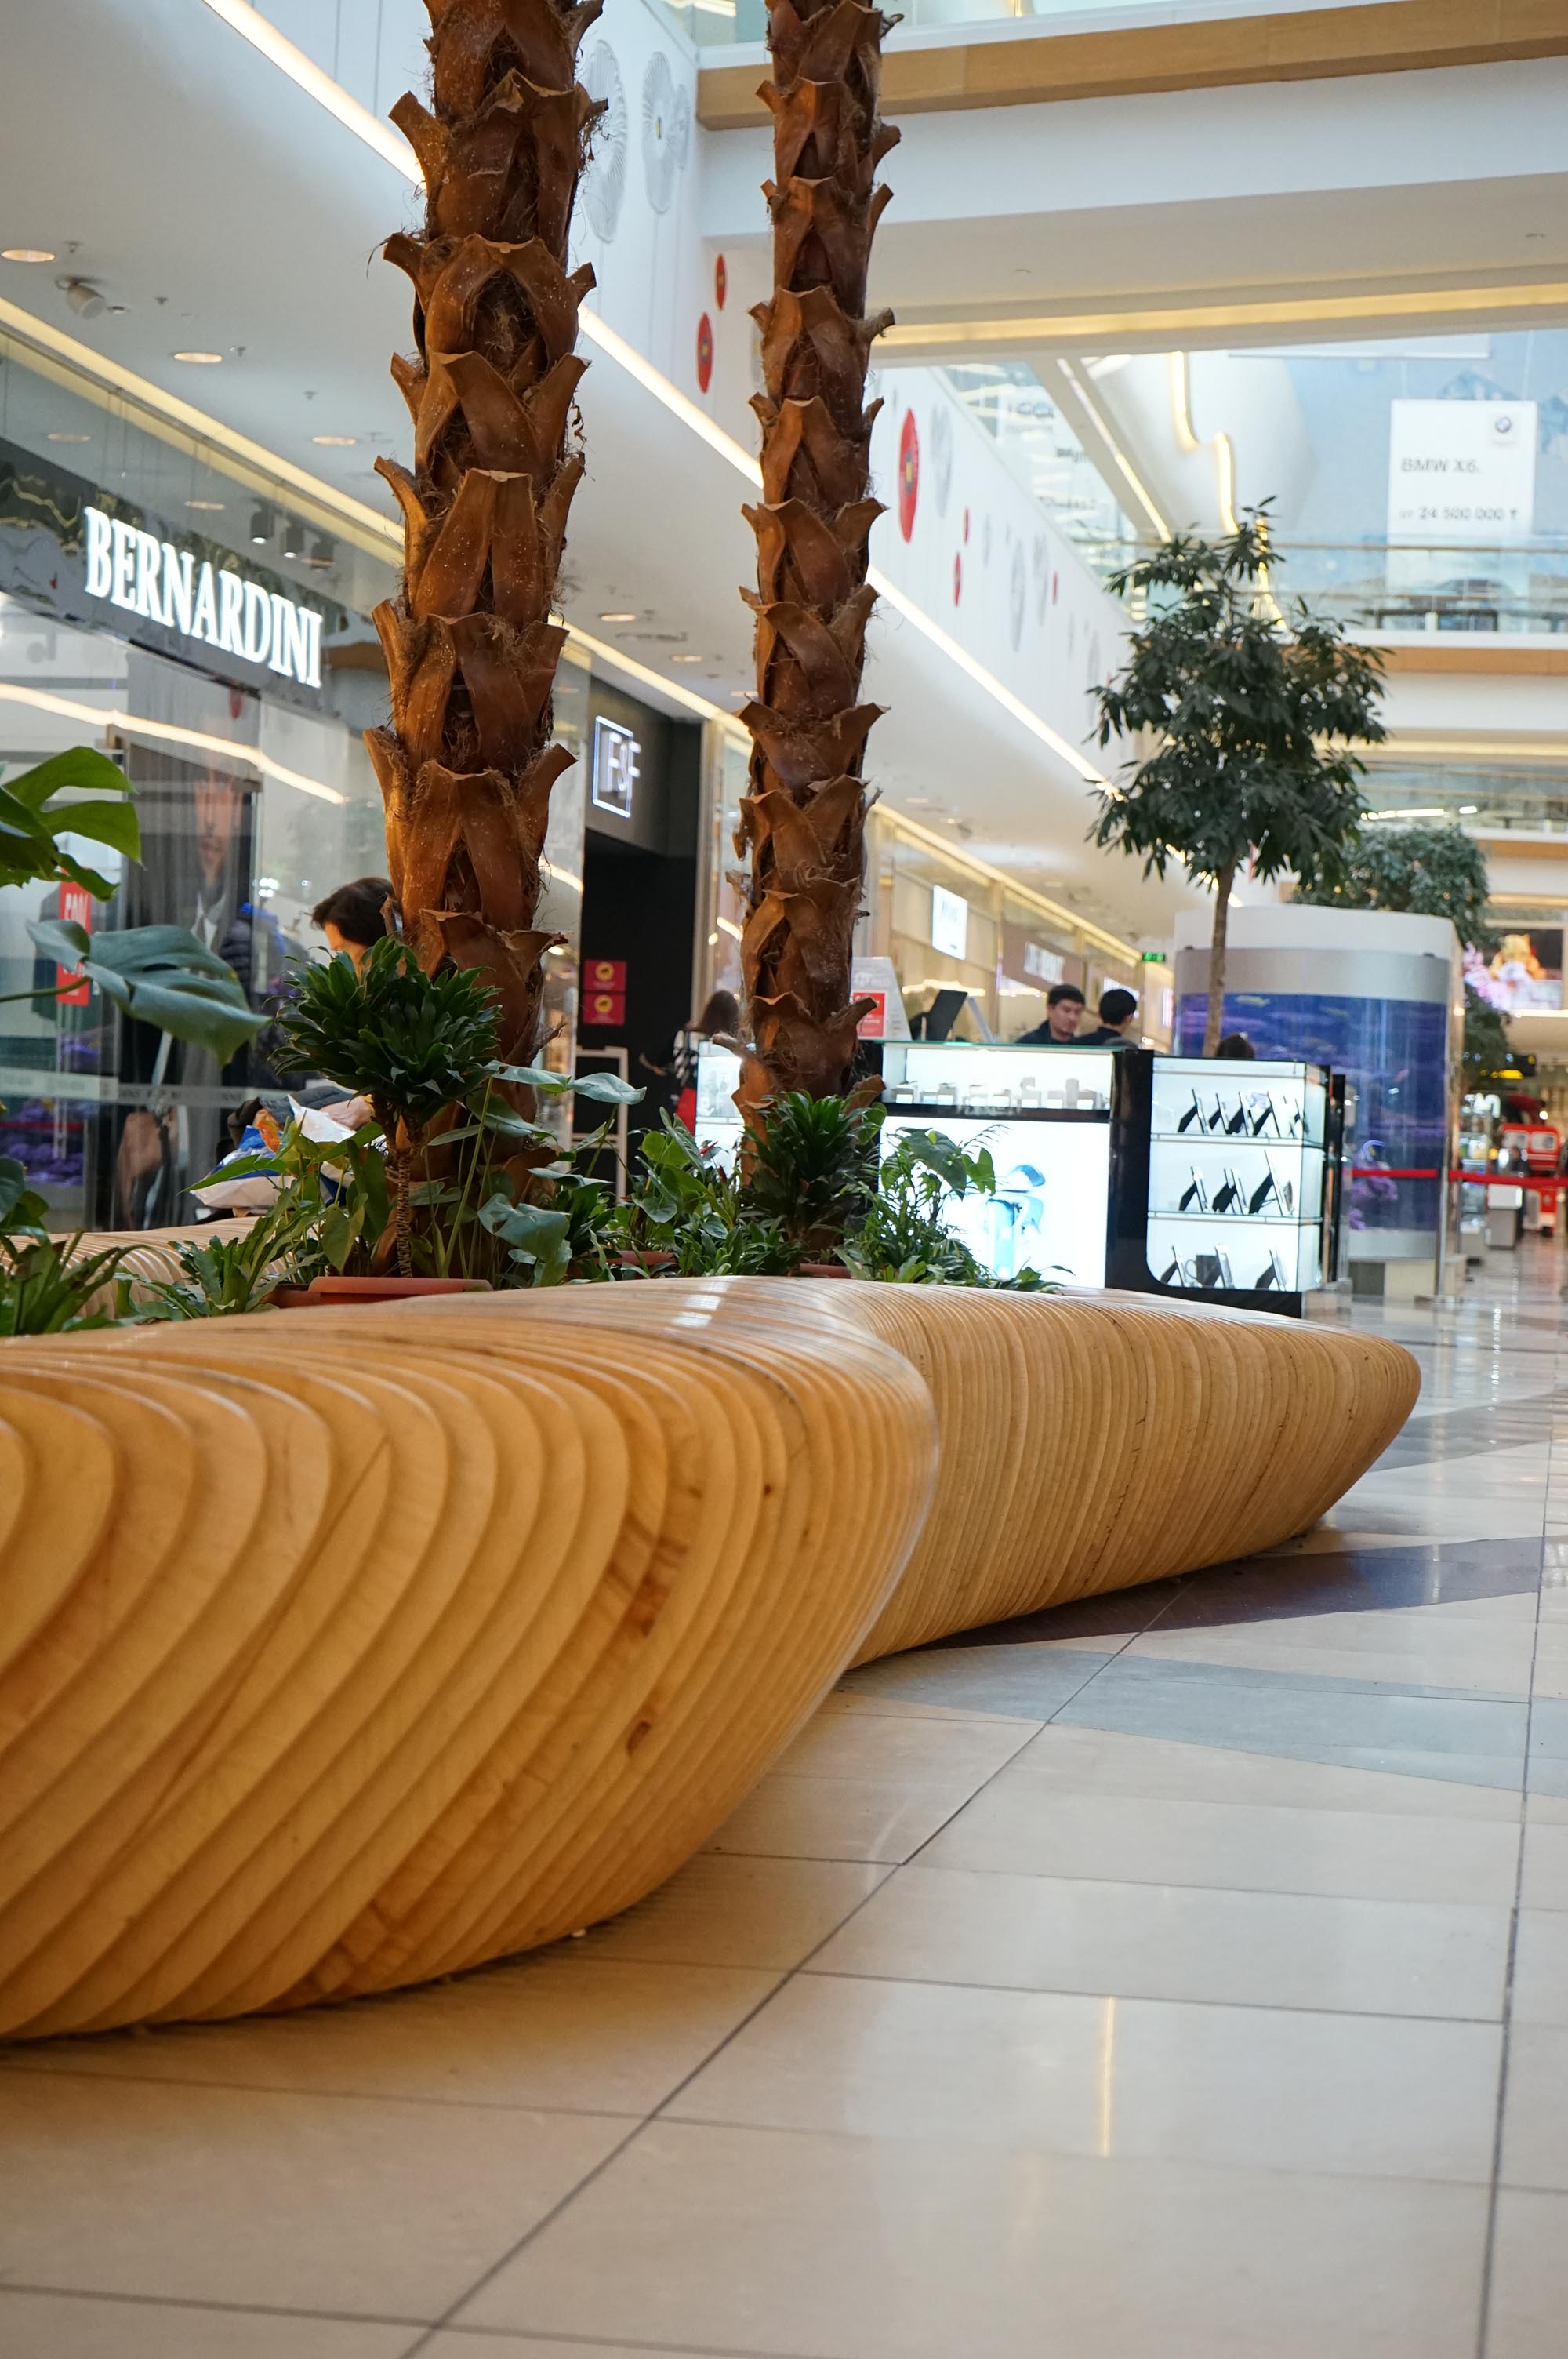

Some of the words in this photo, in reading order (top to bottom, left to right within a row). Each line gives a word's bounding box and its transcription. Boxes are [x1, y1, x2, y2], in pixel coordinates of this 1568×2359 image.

[1401, 458, 1448, 472] BMW
[1419, 507, 1437, 520] 24
[1475, 507, 1505, 521] 000
[84, 506, 323, 689] BERNARDINI
